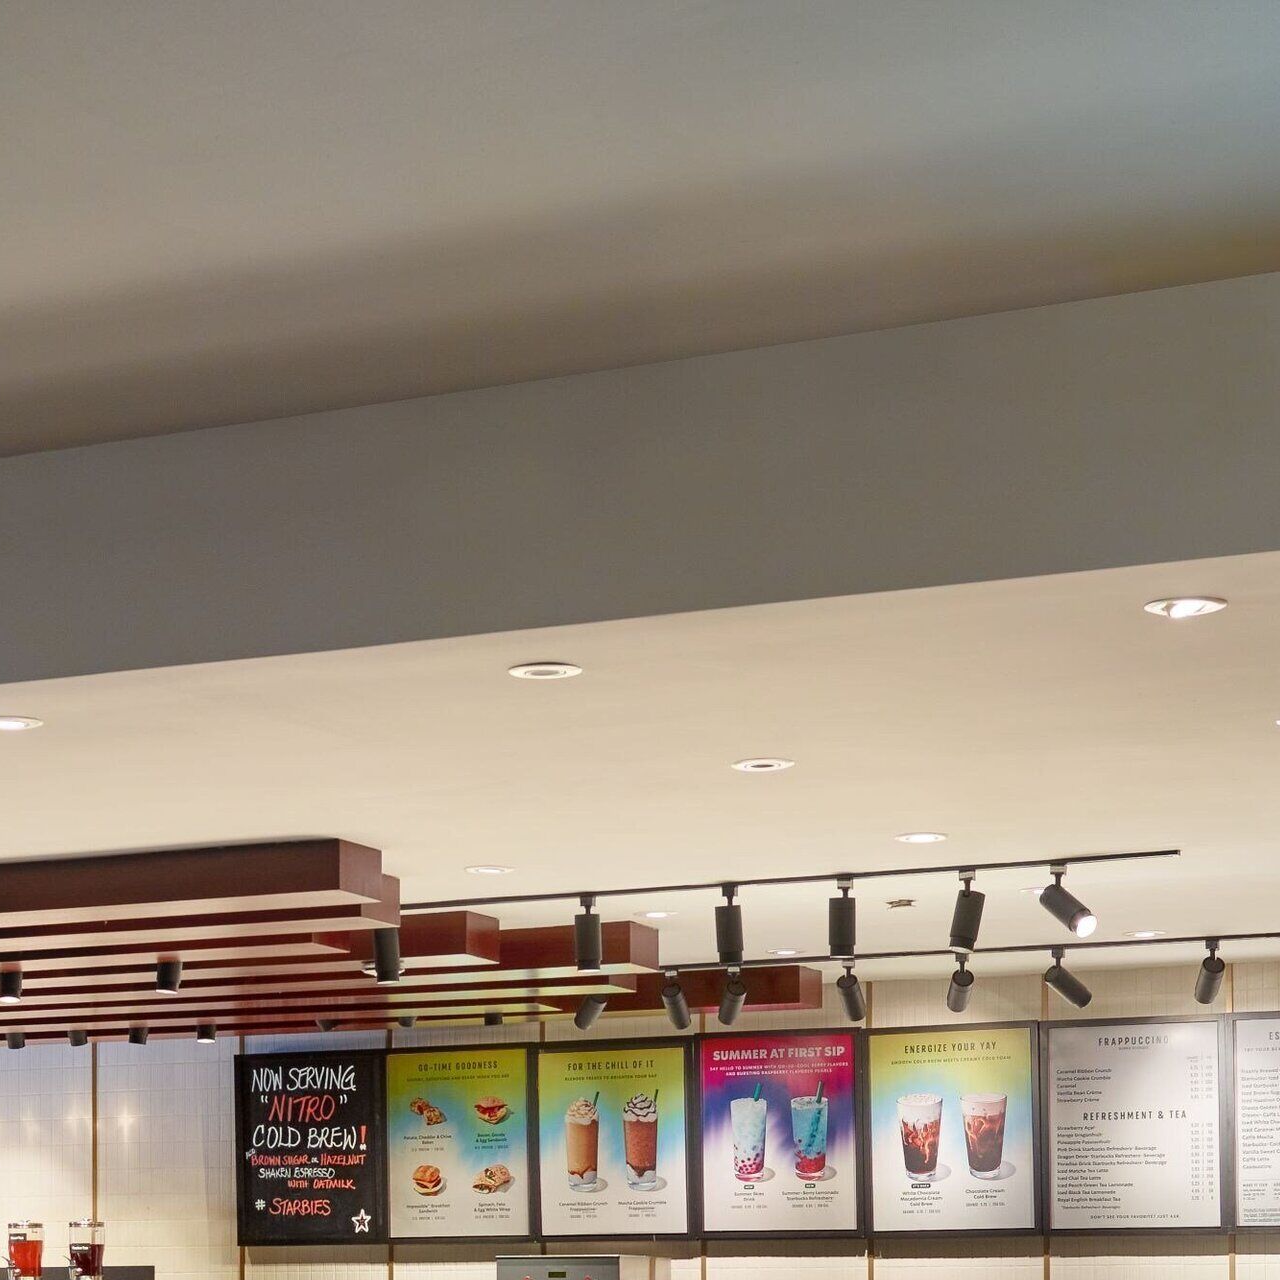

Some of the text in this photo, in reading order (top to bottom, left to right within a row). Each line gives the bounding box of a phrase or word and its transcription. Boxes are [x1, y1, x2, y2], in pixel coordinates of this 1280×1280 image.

[1098, 1035, 1169, 1046] FRAPPUCCINO
[713, 1046, 845, 1061] SUMMER AT FIRST SIP
[904, 1041, 997, 1054] ENERGIZE YOUR YAY
[455, 1060, 498, 1070] GOODNESS
[567, 1059, 654, 1071] FOR THE CHILL OF IT
[251, 1065, 357, 1092] NOW SERVING
[1083, 1109, 1187, 1121] REFRESHMENT & TEA
[252, 1124, 301, 1148] COLD
[251, 1155, 280, 1166] BROWN
[282, 1155, 310, 1166] SUGAR
[320, 1153, 366, 1166] HAZELNUT
[258, 1167, 336, 1179] SHAKEN ESPRESSO
[313, 1179, 356, 1190] OATMILK
[268, 1197, 331, 1216] STARBIES
